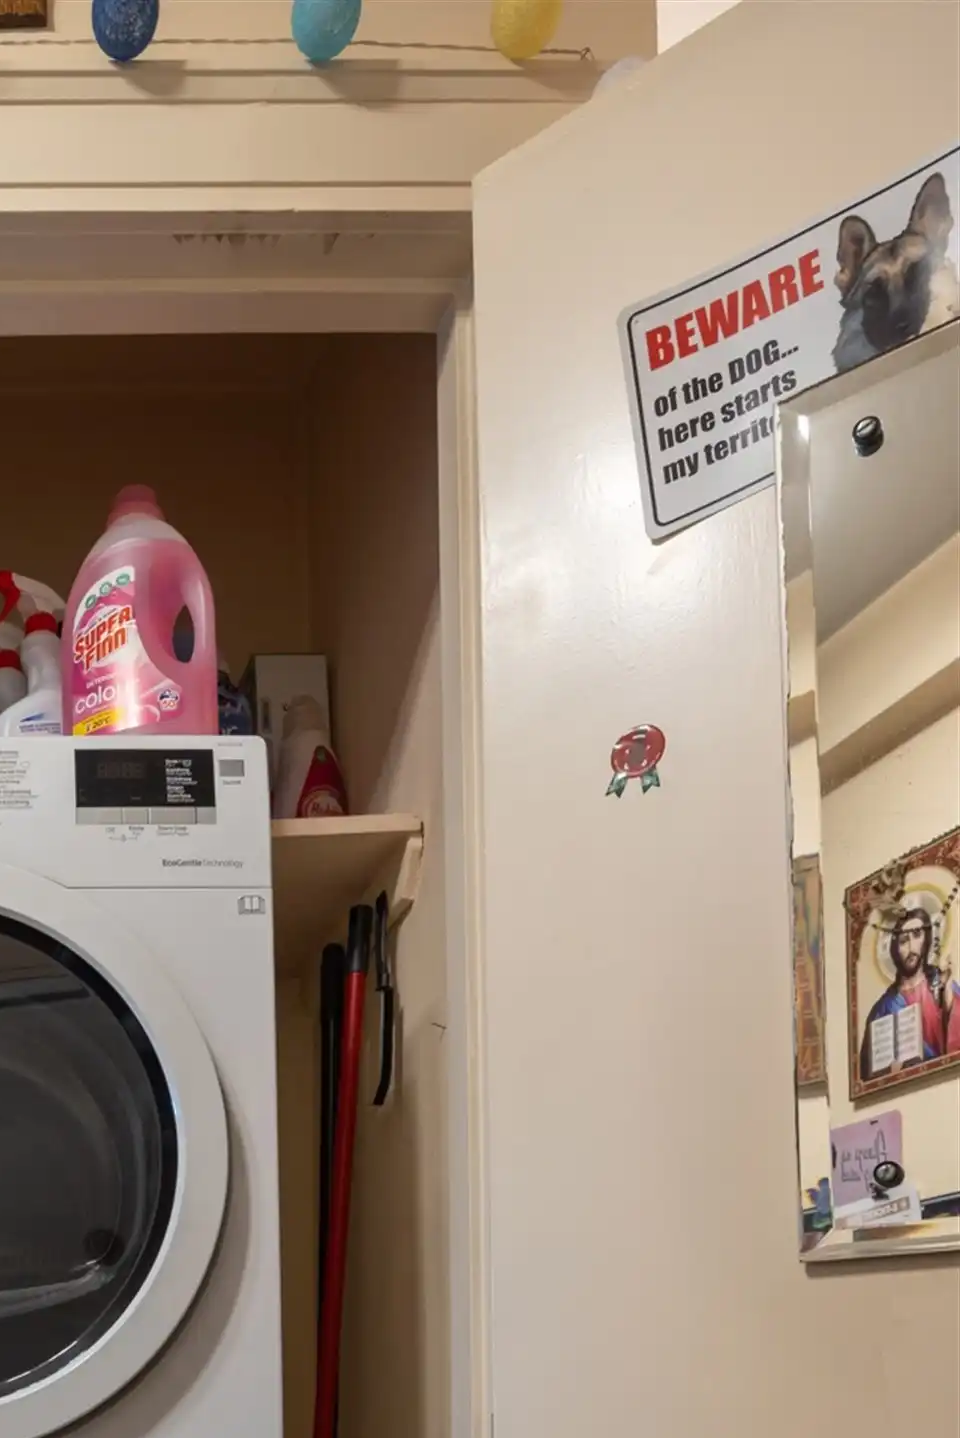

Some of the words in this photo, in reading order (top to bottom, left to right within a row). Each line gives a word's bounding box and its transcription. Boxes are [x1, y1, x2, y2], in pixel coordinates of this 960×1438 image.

[644, 248, 825, 372] BEWARE
[653, 386, 679, 417] of
[681, 371, 723, 403] the
[727, 338, 800, 383] DOG...
[657, 409, 716, 452] here
[719, 369, 798, 424] starts
[661, 450, 700, 485] my
[703, 415, 774, 466] territ
